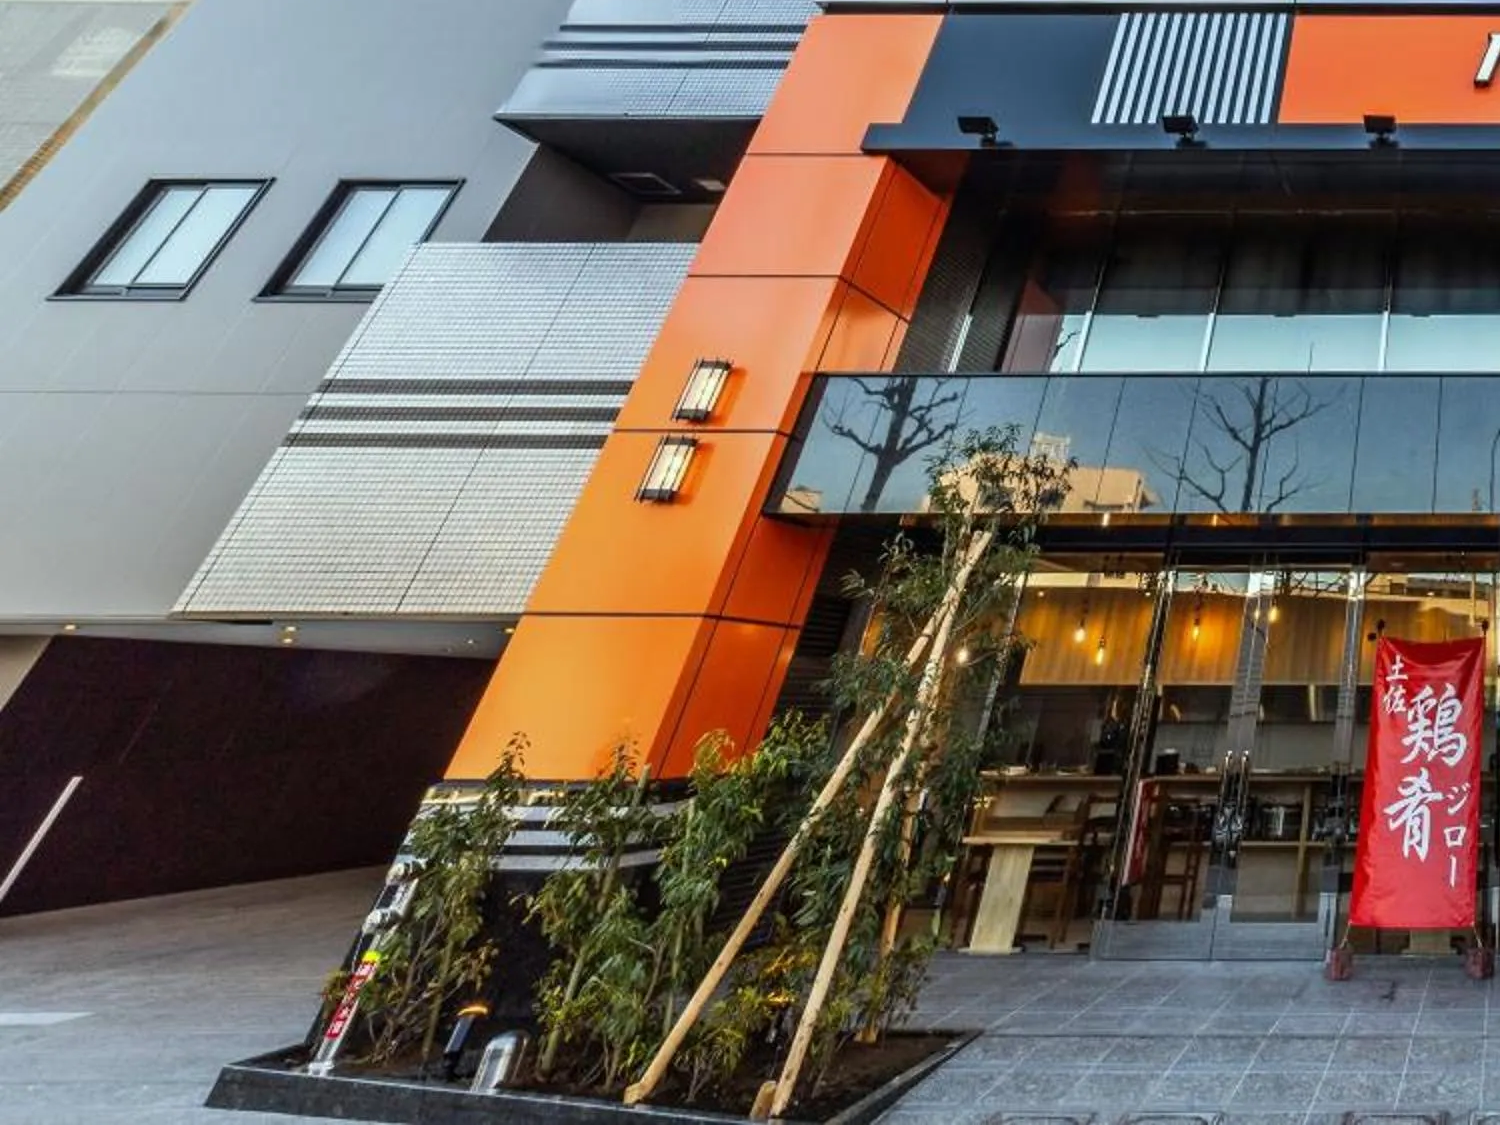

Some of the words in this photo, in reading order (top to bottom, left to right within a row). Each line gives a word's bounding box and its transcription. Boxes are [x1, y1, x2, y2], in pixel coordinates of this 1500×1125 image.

[1383, 654, 1409, 714] 土佐
[1443, 780, 1471, 888] ジロー
